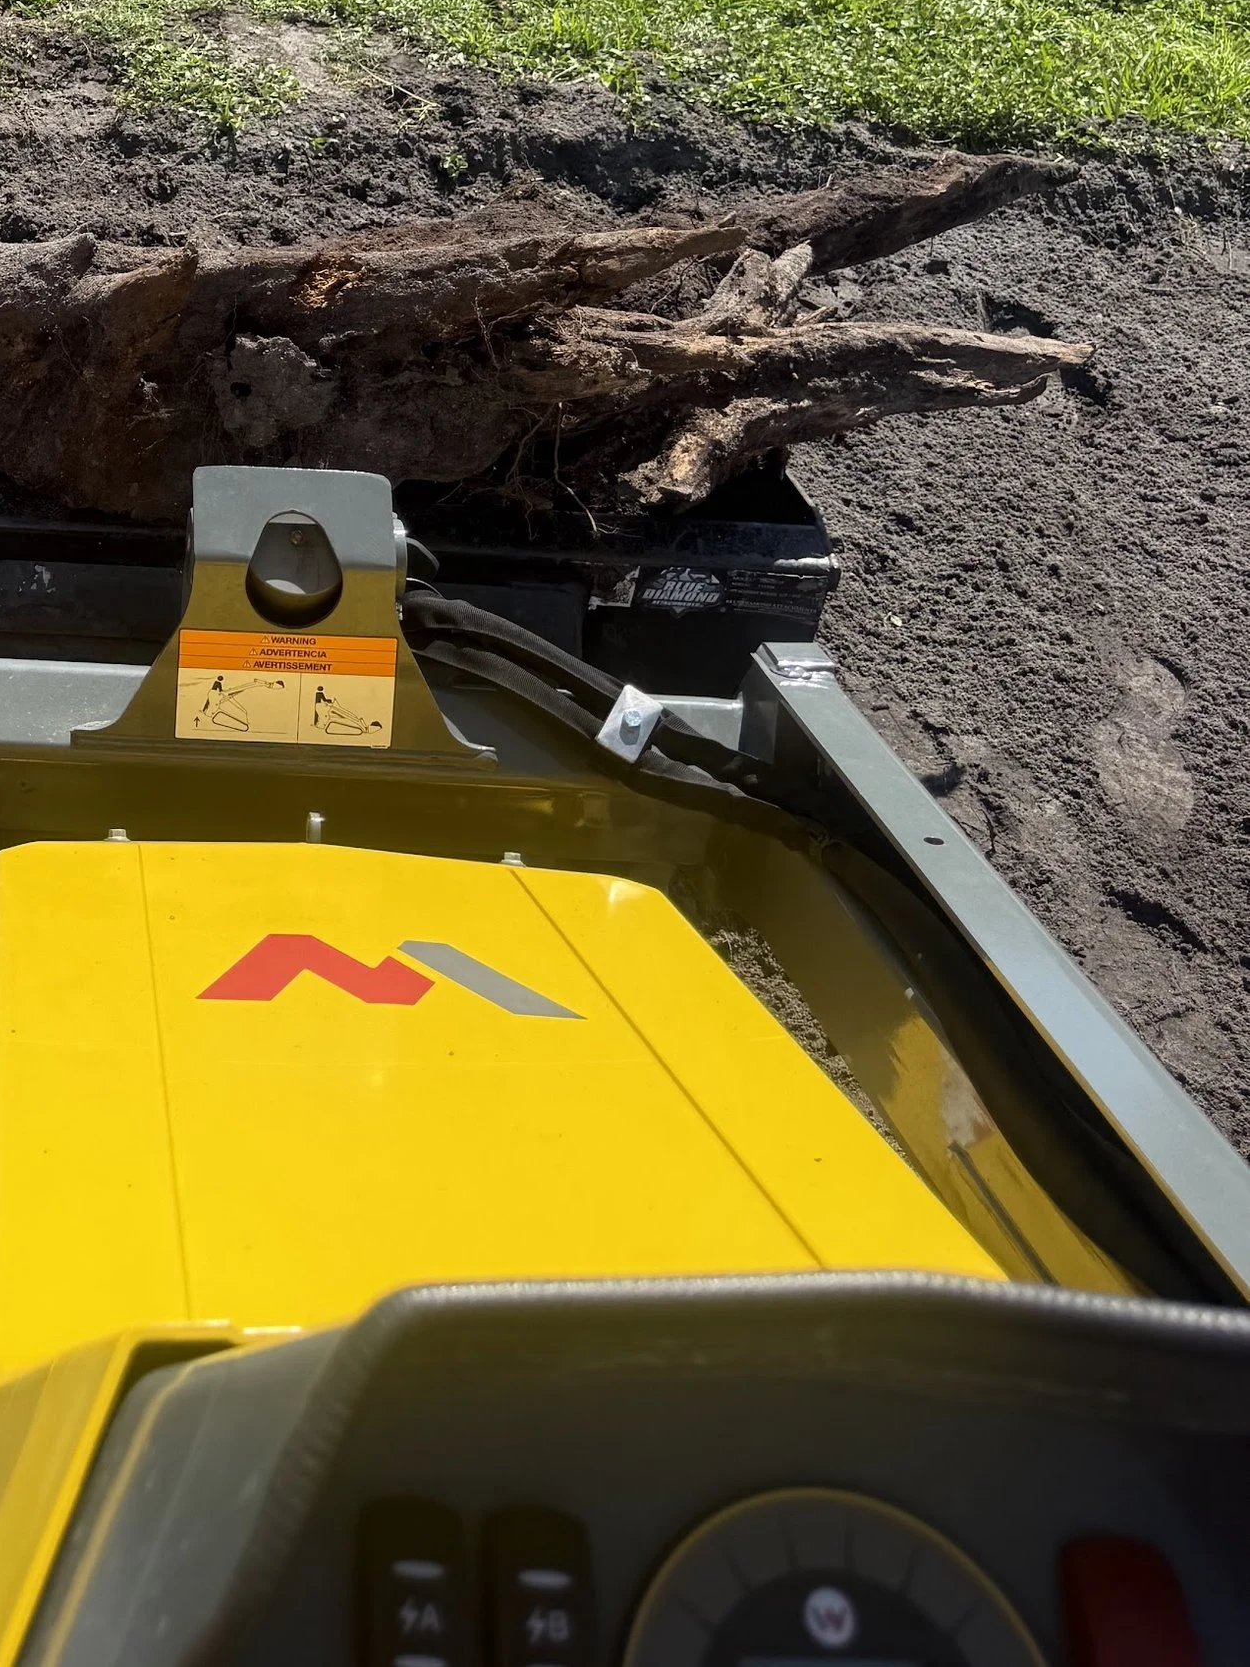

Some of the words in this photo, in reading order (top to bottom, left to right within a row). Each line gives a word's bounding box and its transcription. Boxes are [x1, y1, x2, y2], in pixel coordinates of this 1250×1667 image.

[663, 580, 706, 593] BLUE
[642, 588, 720, 603] DIAMOND
[271, 636, 317, 646] WARNING
[259, 648, 327, 658] ADVERTENCIA
[253, 660, 332, 671] AVERTISSEMENT
